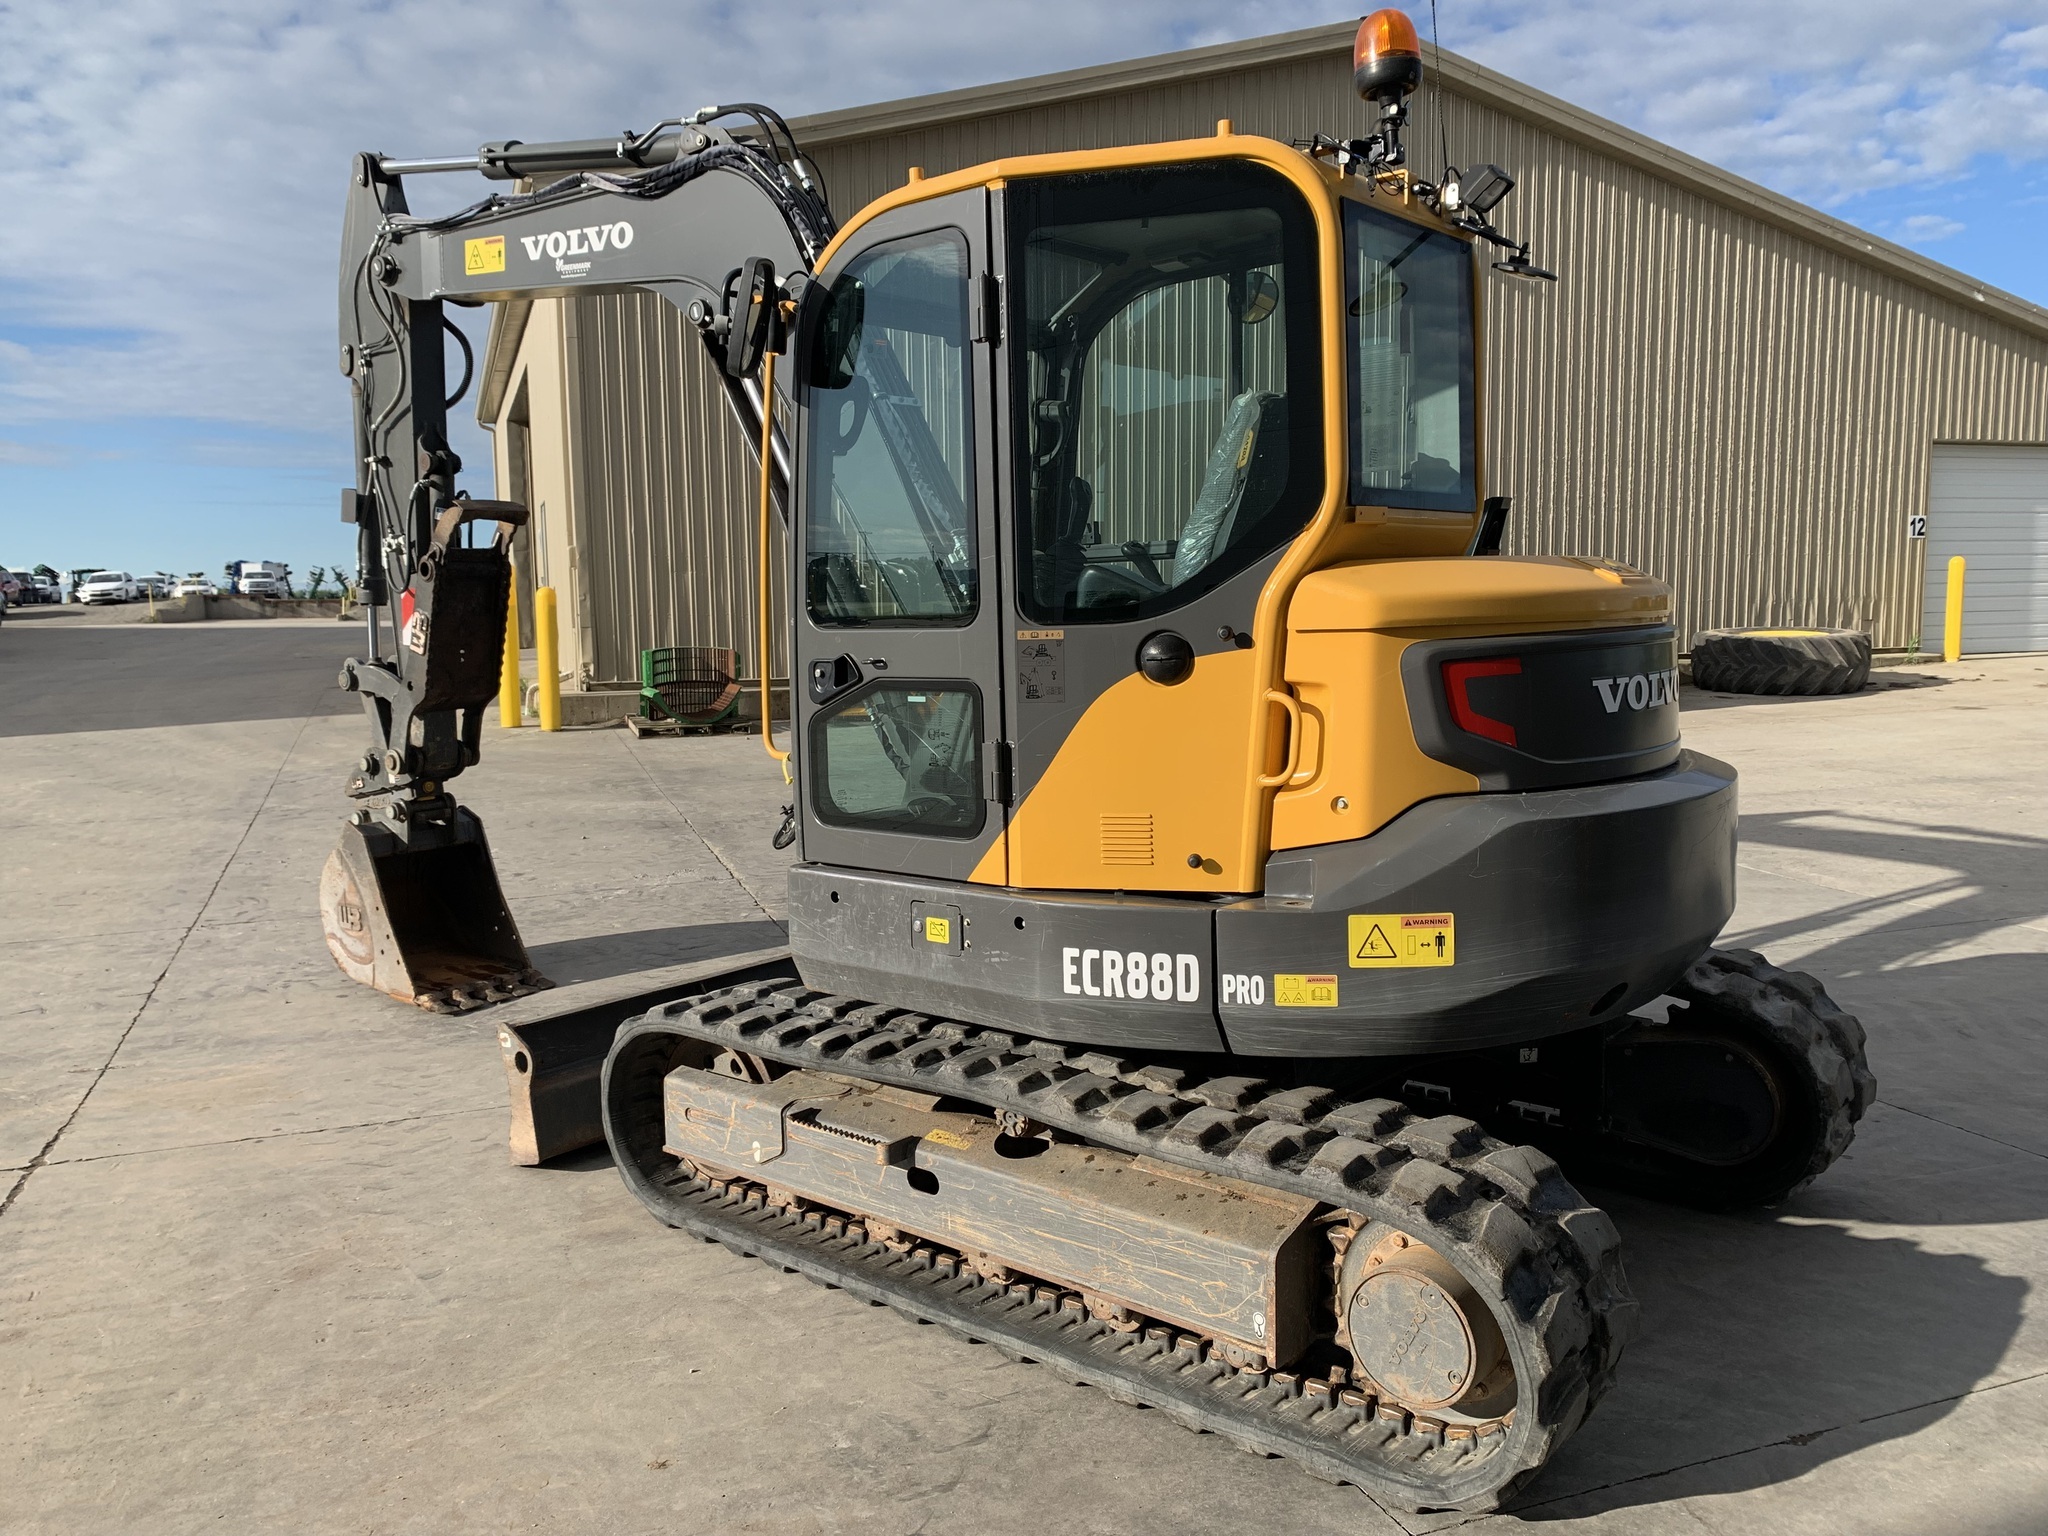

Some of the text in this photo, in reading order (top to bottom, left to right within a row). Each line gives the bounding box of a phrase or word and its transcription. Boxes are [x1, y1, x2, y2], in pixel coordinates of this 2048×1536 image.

[521, 221, 634, 261] VOLVO
[1910, 517, 1926, 537] 12
[1592, 666, 1680, 714] VOLVO
[1412, 918, 1449, 926] WARNING
[1062, 947, 1200, 1002] ECR88D
[1222, 973, 1265, 1006] PRO
[1388, 1310, 1427, 1365] VOLVO
